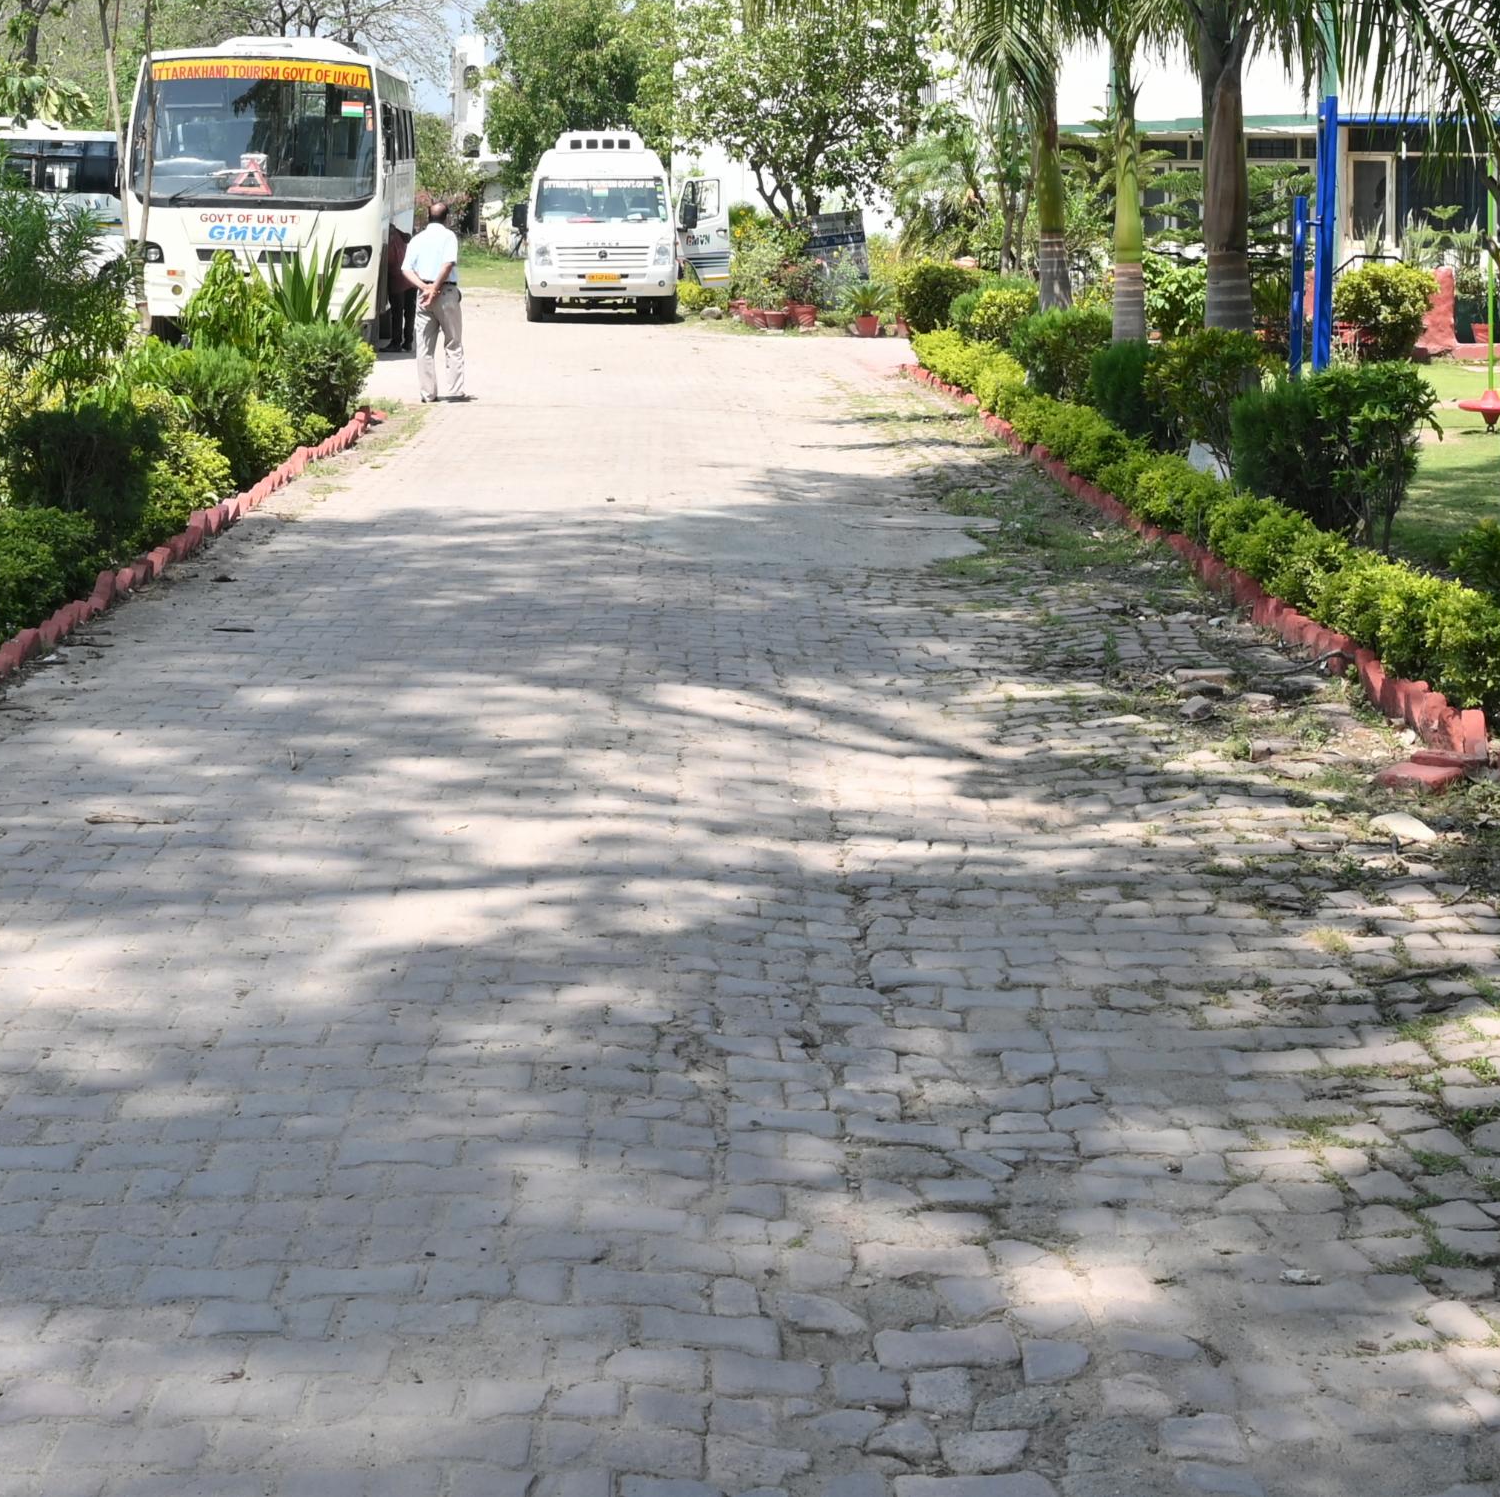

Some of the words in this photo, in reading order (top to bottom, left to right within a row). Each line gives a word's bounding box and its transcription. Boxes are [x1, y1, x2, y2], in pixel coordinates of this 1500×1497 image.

[231, 65, 279, 80] TOURISM
[315, 69, 332, 84] OF
[237, 214, 253, 223] OF
[257, 214, 275, 224] UK
[208, 225, 287, 241] GMVN
